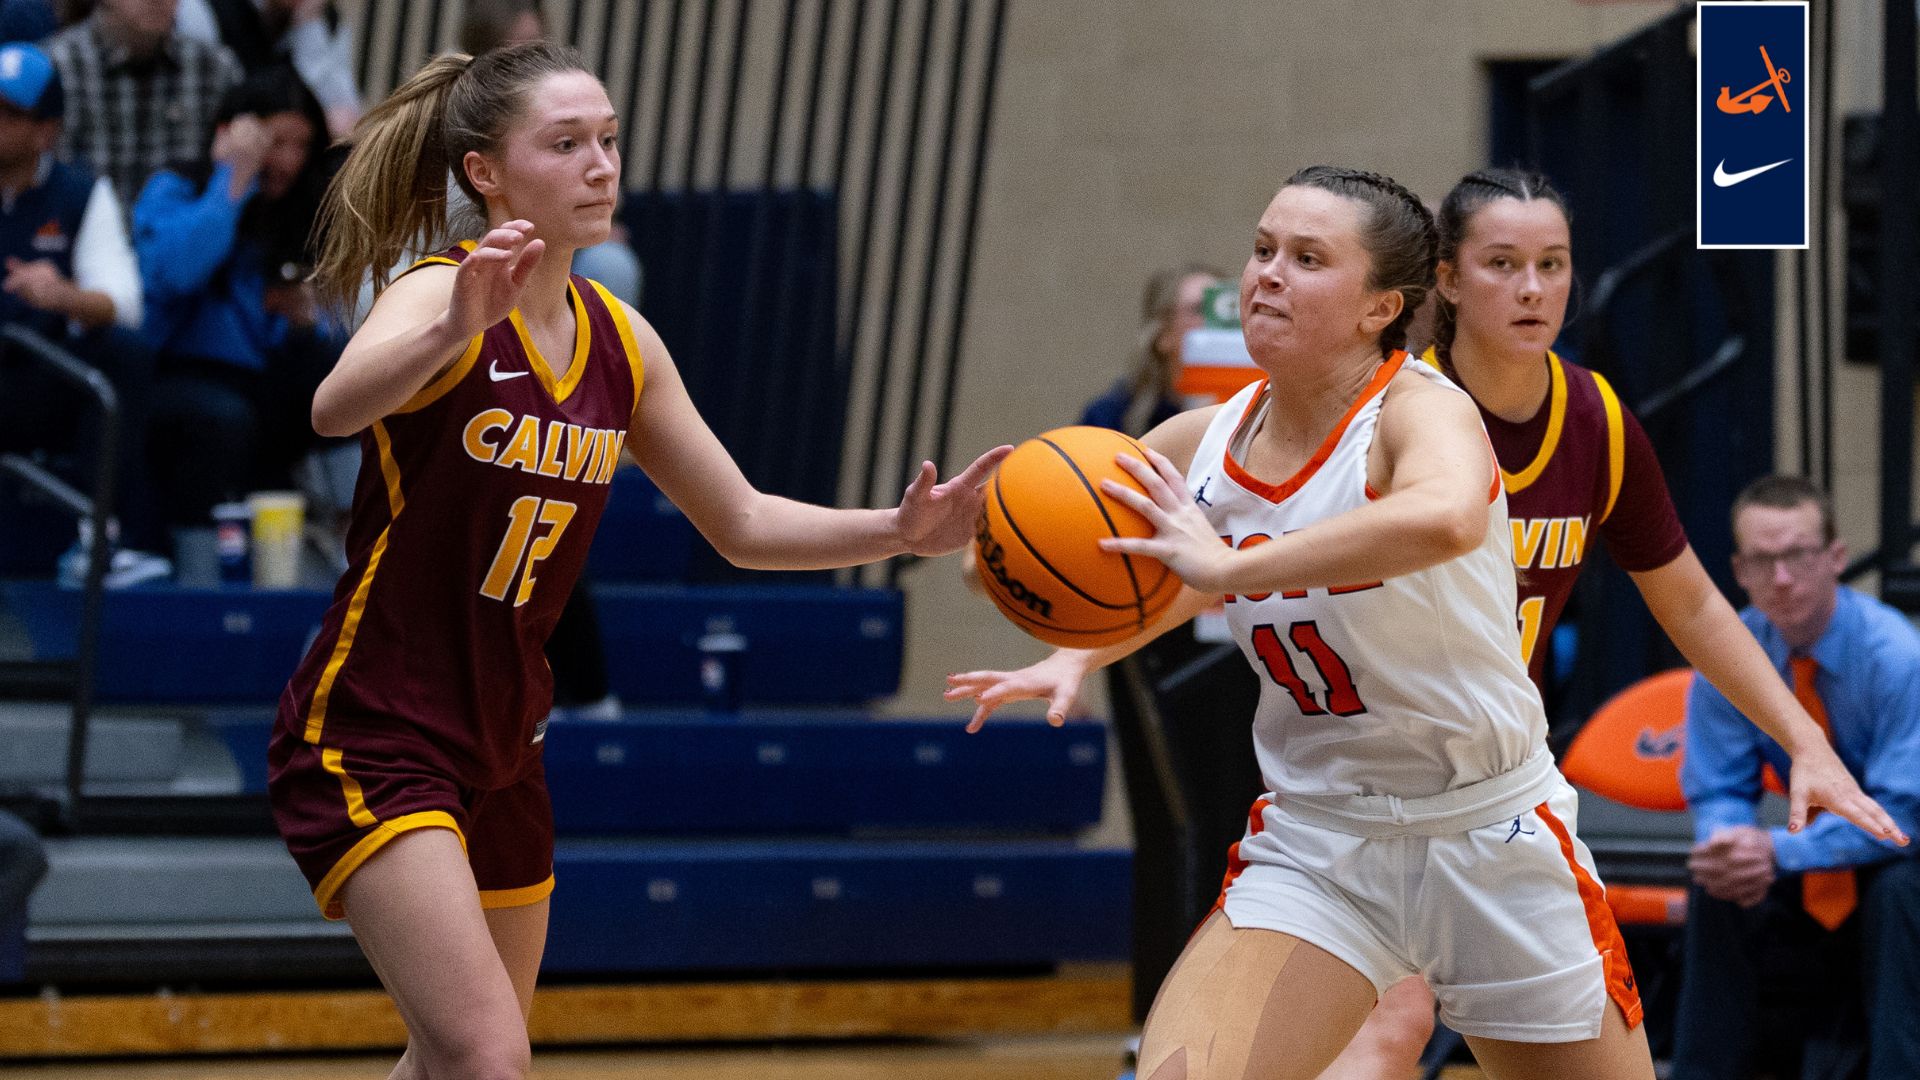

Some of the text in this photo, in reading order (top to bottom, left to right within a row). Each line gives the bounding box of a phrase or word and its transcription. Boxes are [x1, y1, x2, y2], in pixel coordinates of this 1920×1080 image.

[462, 408, 627, 484] CALVIN
[478, 495, 577, 608] 12
[1252, 620, 1368, 717] 11
